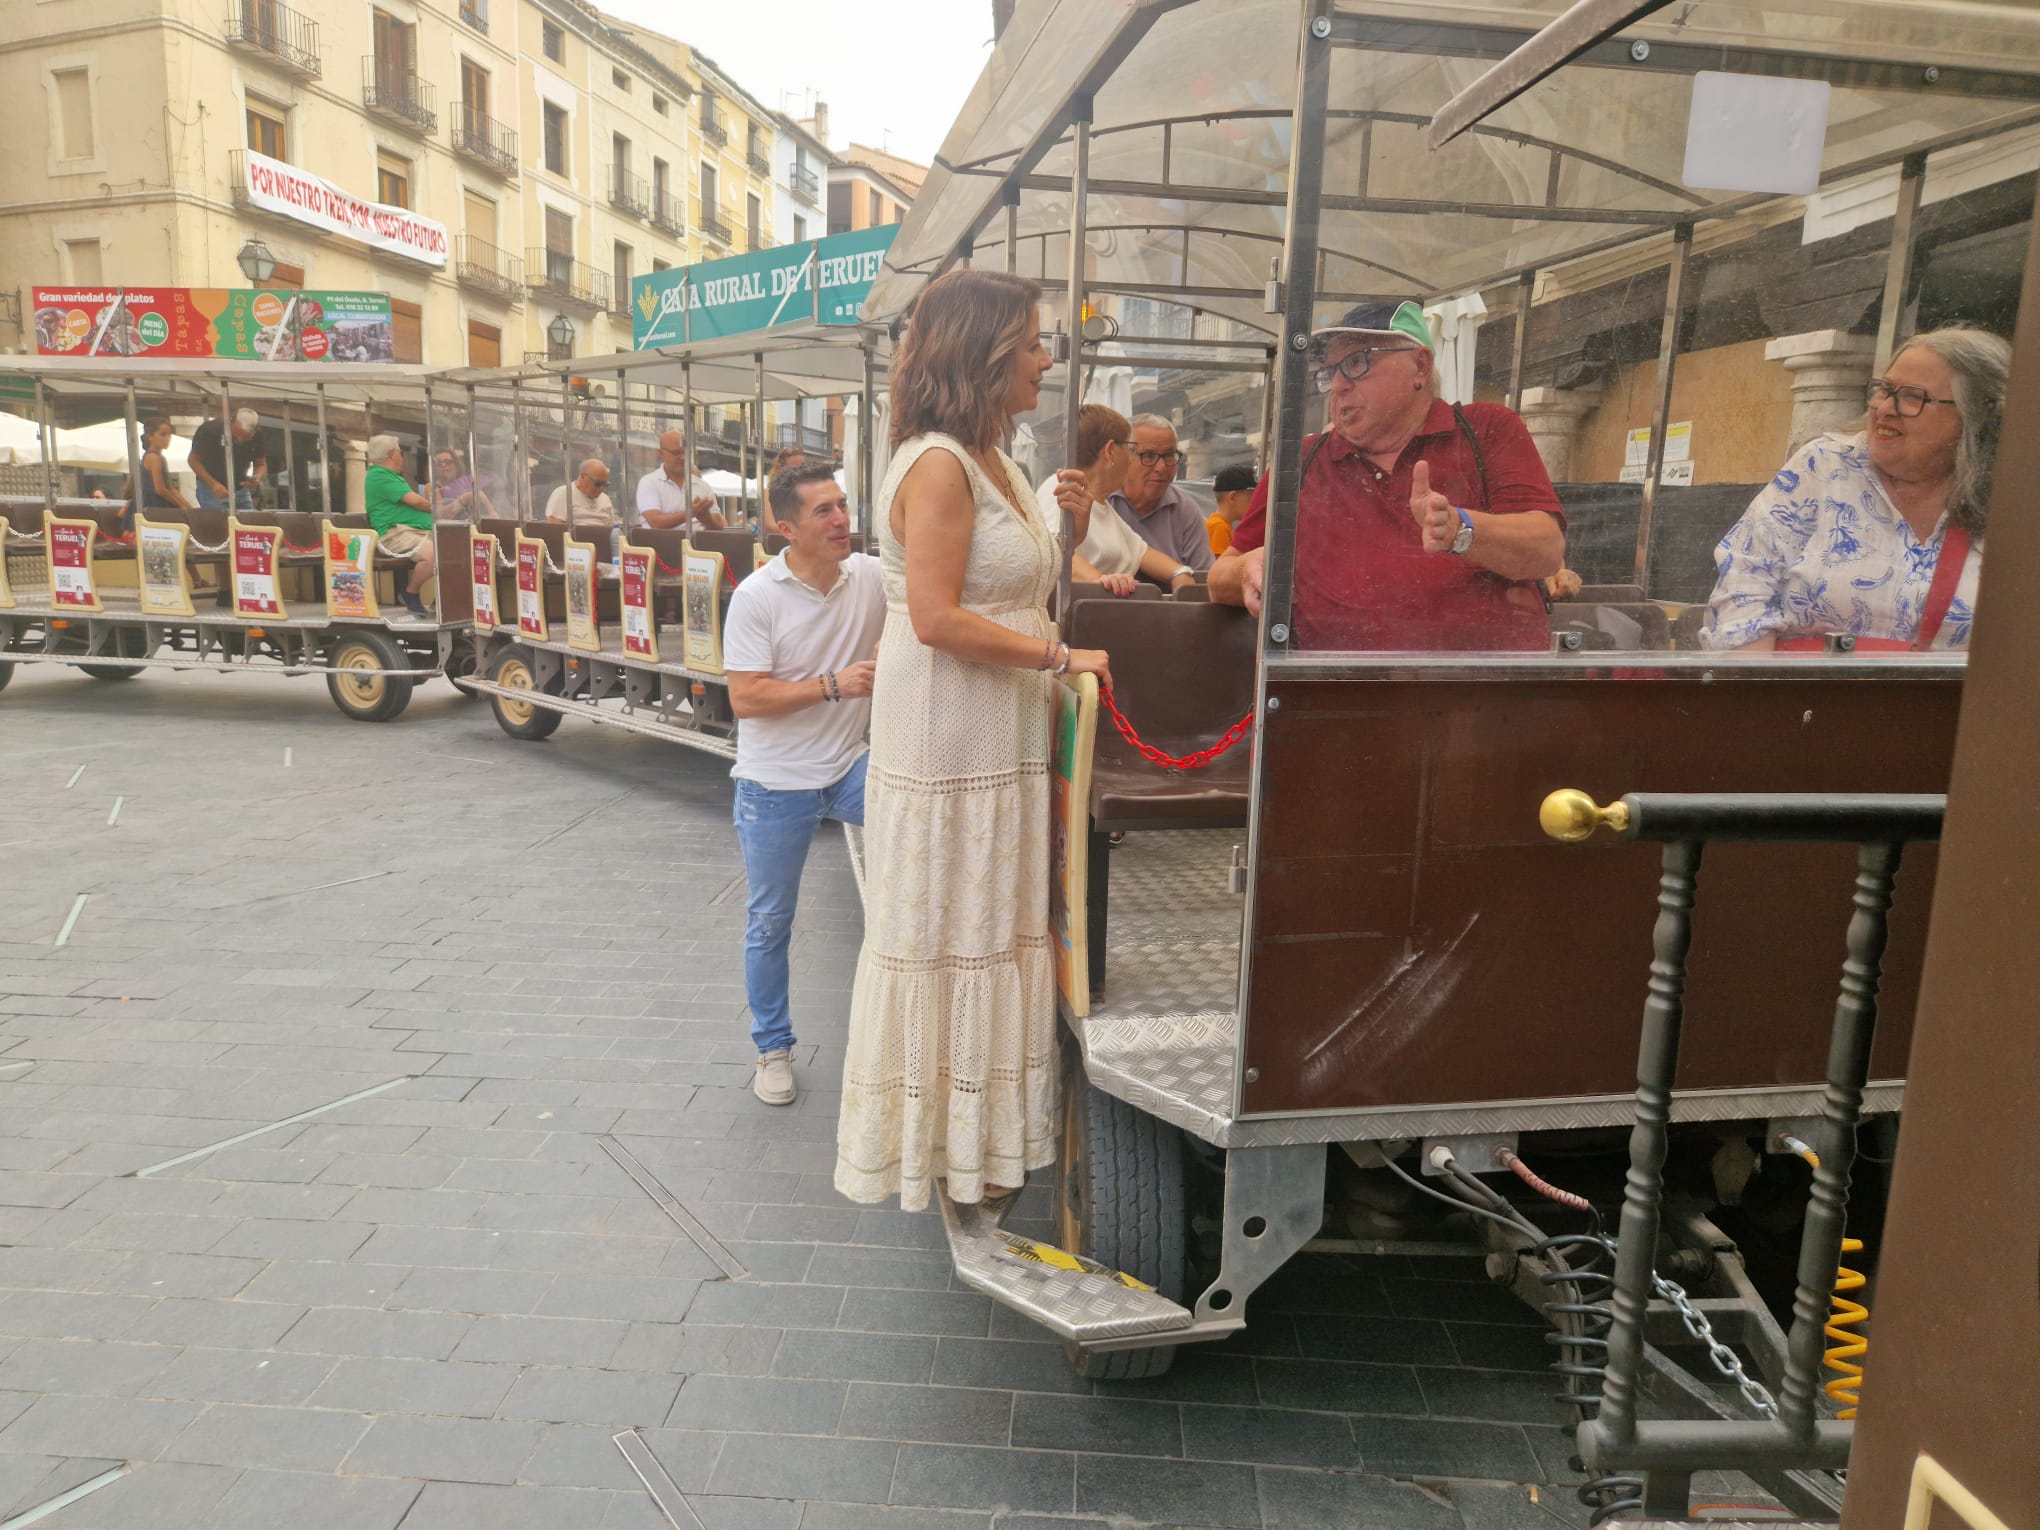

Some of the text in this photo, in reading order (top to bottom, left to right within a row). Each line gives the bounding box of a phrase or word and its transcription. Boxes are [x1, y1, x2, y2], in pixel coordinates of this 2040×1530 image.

[251, 163, 274, 197] POR
[275, 171, 322, 213] NUESTRO
[350, 202, 372, 232] POR
[372, 210, 413, 246] NUESTRO
[413, 221, 446, 254] FUTURO
[661, 283, 702, 314] CAJA
[704, 272, 766, 307] RURAL
[771, 265, 798, 297] DE
[40, 292, 62, 302] Gran
[63, 292, 105, 303] variedad
[125, 293, 155, 305] platos
[144, 319, 163, 329] MENÚ
[173, 292, 190, 353] Tapas
[231, 293, 249, 354] Copas
[141, 328, 165, 339] del DÍA
[55, 534, 79, 543] TERUEL
[239, 540, 265, 550] TERUEL
